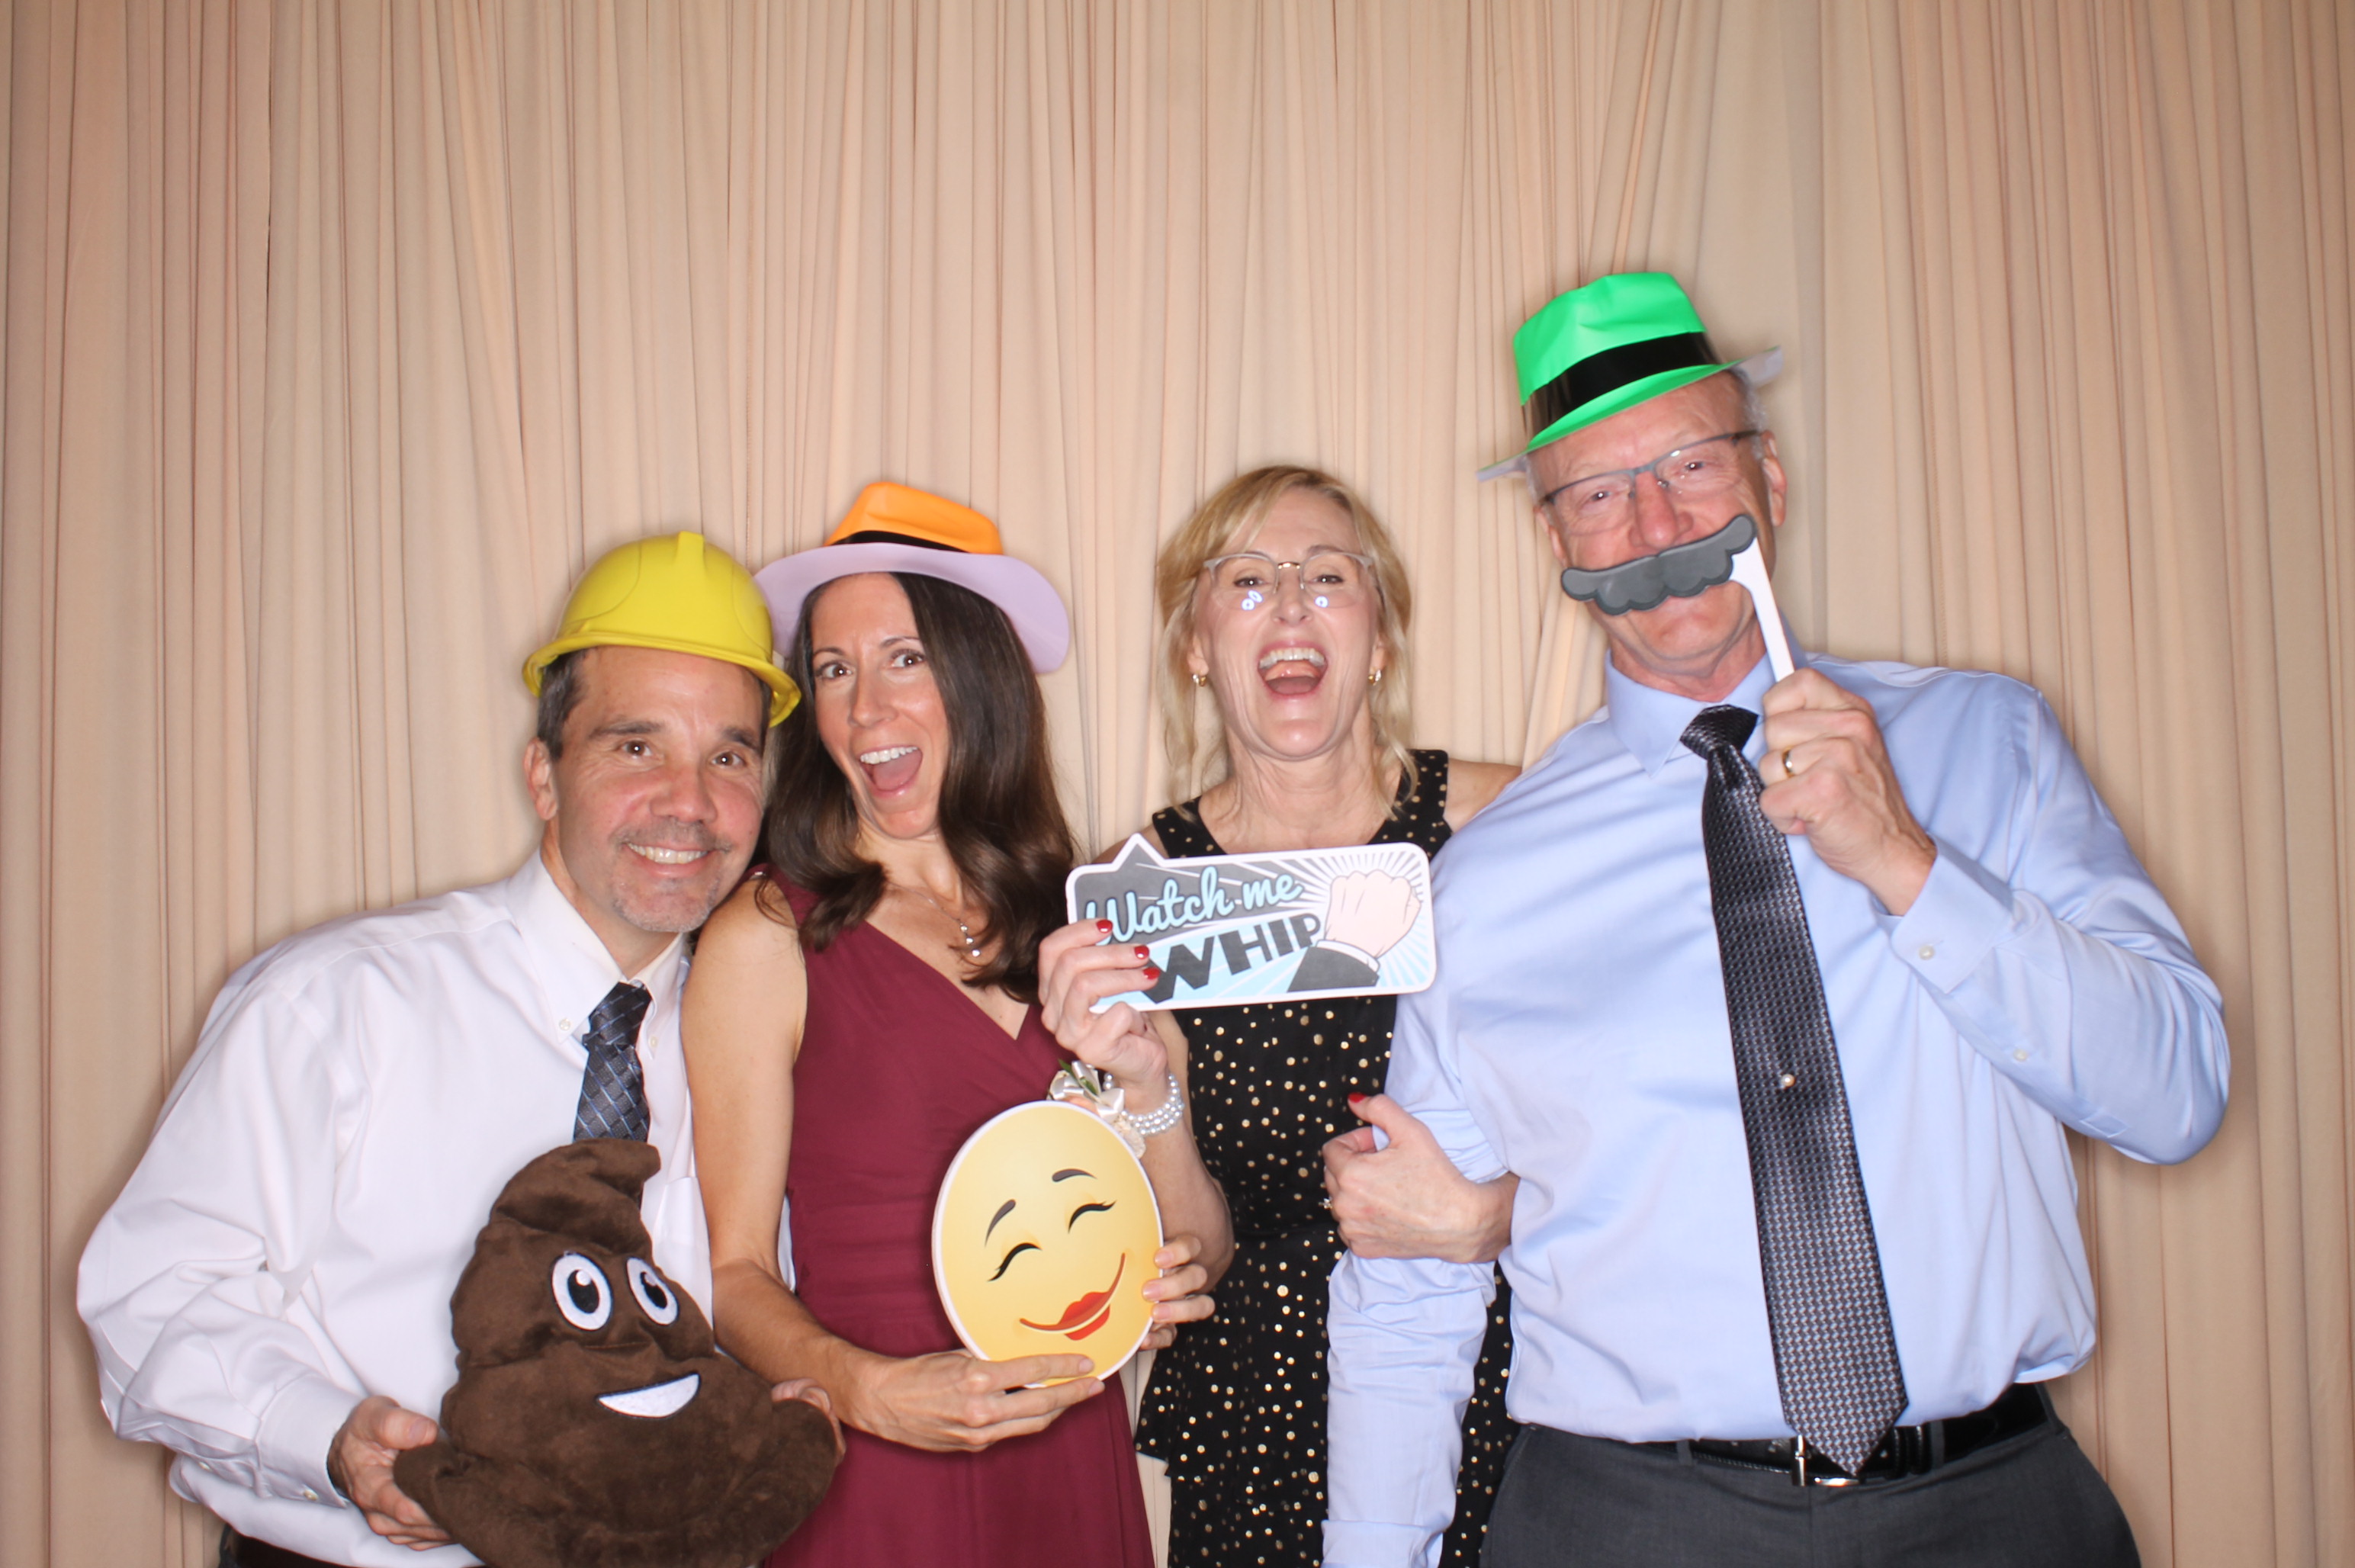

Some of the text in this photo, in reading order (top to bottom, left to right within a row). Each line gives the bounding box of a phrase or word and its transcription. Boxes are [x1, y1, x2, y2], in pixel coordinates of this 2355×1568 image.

[1086, 866, 1305, 946] Watch me
[1141, 913, 1321, 1004] WHIP
